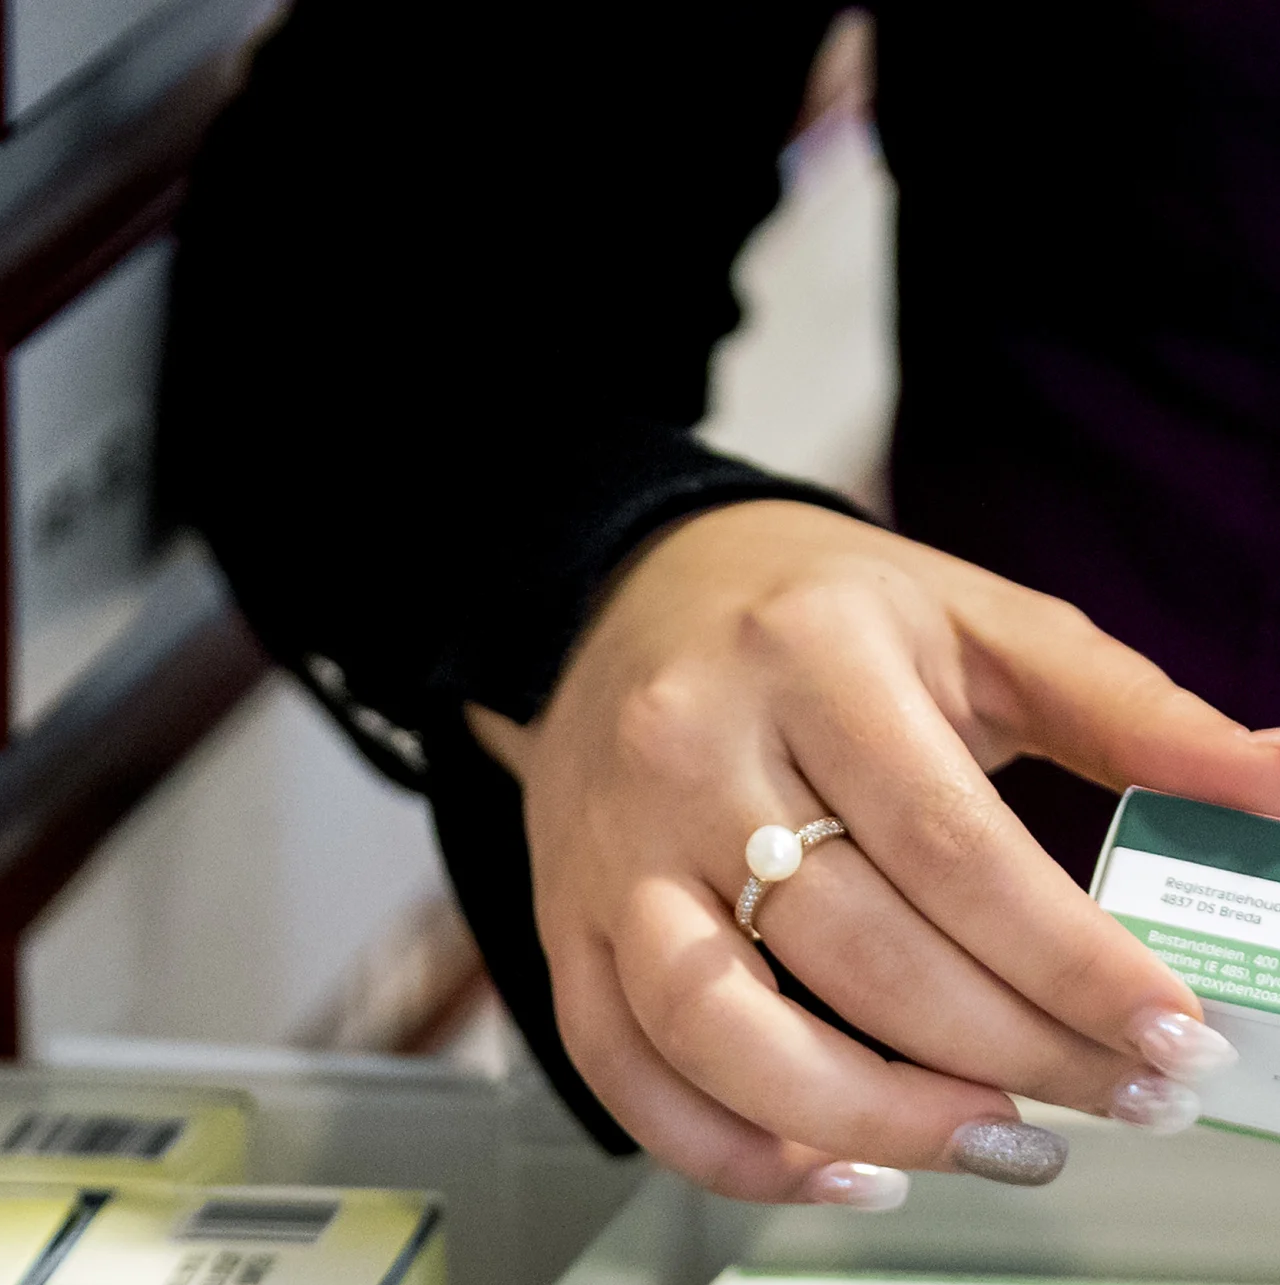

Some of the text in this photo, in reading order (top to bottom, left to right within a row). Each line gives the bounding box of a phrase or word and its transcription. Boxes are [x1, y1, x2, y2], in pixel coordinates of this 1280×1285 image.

[1160, 892, 1262, 925] 4837 DS Breda
[1253, 954, 1279, 971] 400
